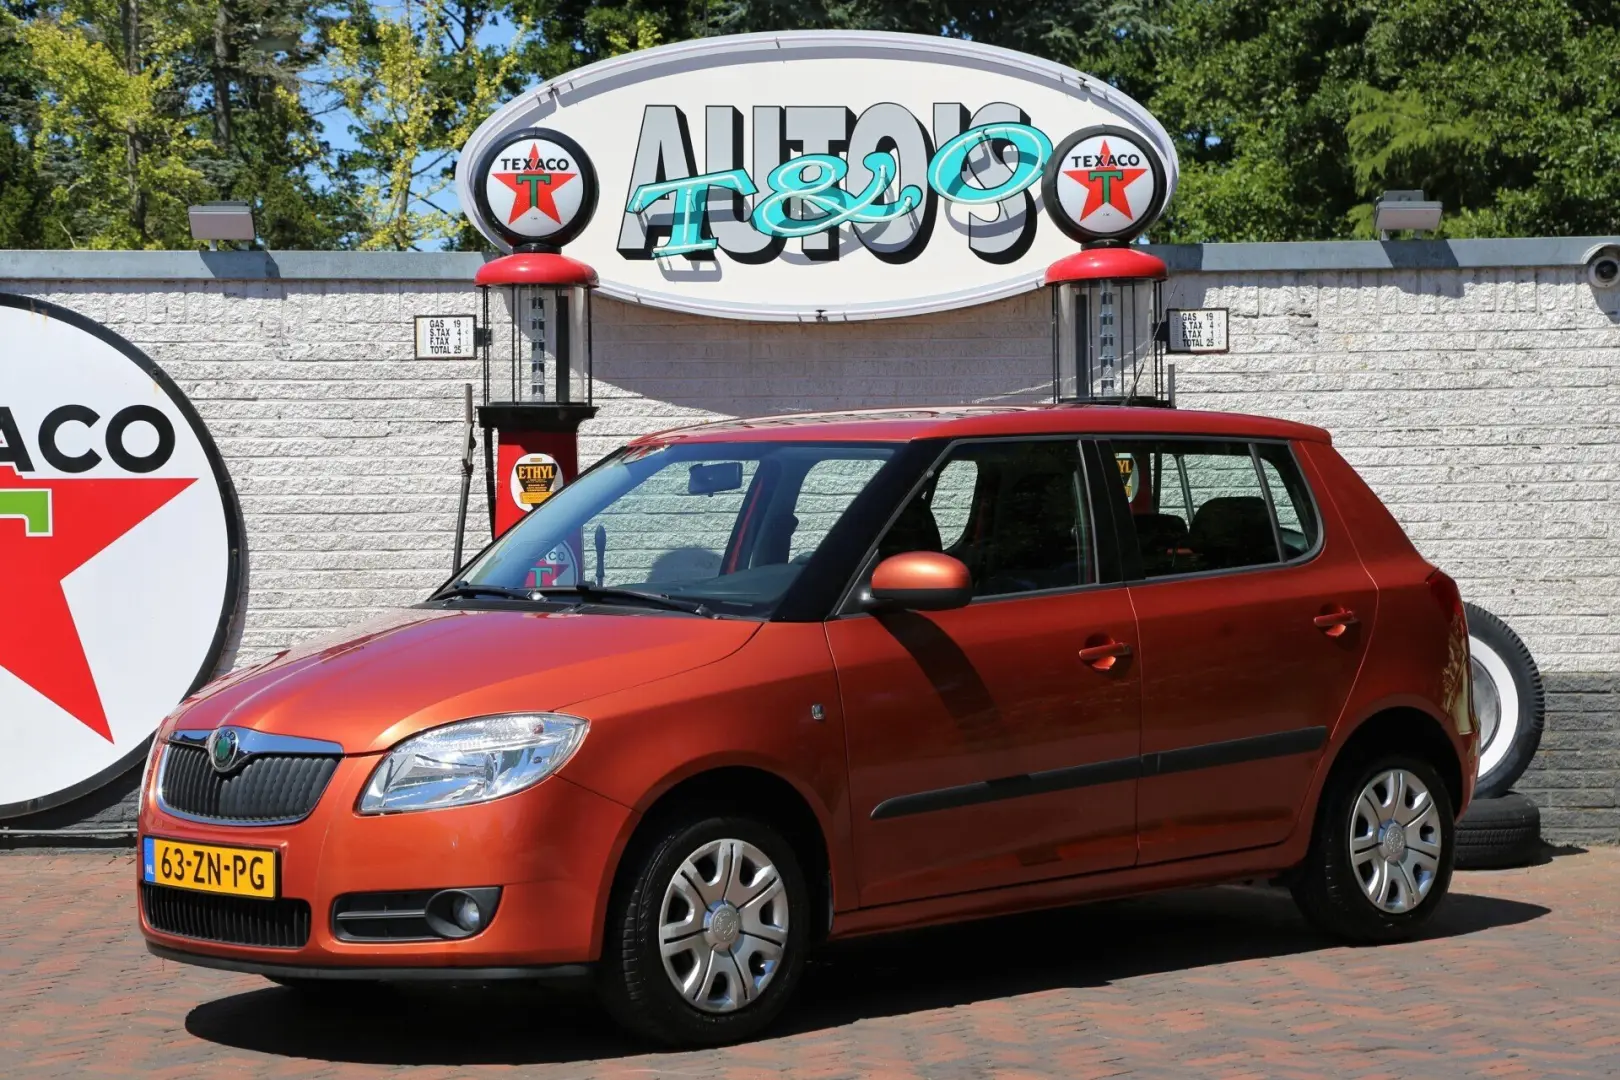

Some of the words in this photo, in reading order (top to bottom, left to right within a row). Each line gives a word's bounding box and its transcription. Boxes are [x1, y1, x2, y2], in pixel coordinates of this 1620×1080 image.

[500, 158, 569, 171] TEXACO
[1071, 154, 1140, 167] TEXACO
[617, 102, 1038, 265] AUTO'S
[1182, 313, 1197, 321] GAS
[1206, 312, 1214, 321] 19
[429, 320, 445, 328] GAS
[453, 319, 461, 328] 19
[1182, 321, 1203, 330] S.TAX
[1209, 321, 1214, 329] 4
[429, 328, 450, 337] S.TAX
[456, 328, 461, 337] 4
[1210, 330, 1214, 338] 1
[429, 337, 450, 346] F.TAX
[457, 337, 461, 345] 1
[1182, 339, 1204, 347] TOTAL
[1206, 338, 1214, 347] 25
[430, 345, 451, 354] TOTAL
[453, 345, 462, 354] 25
[0, 404, 176, 474] ACO
[518, 465, 554, 479] ETHYL
[146, 864, 155, 875] NL
[161, 846, 265, 891] 63-ZN-PG
